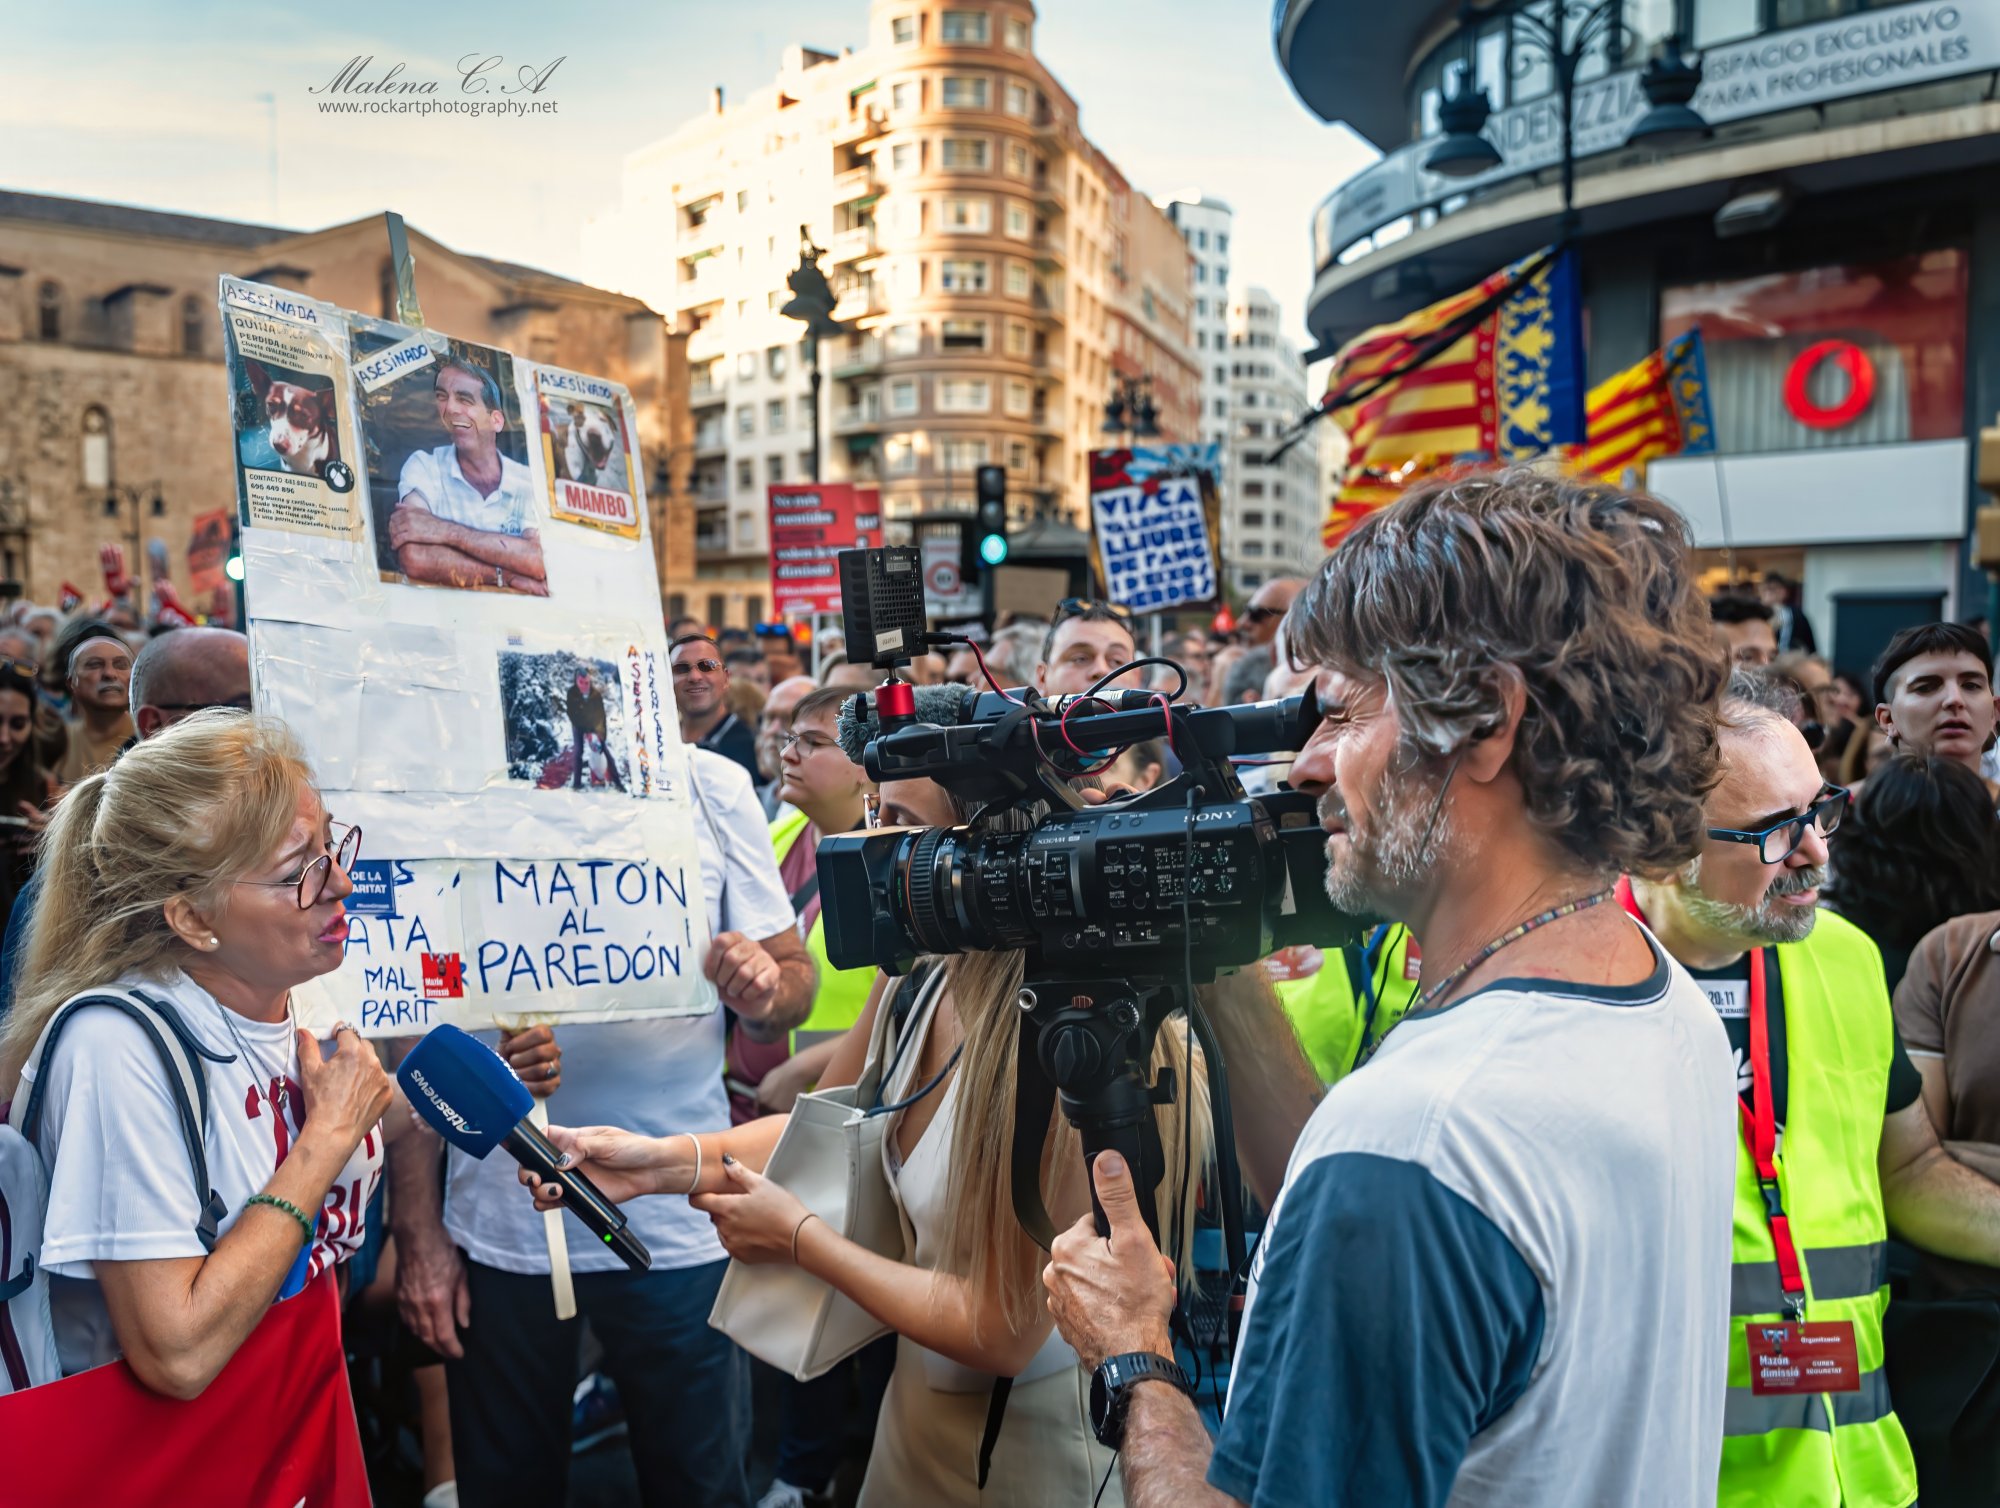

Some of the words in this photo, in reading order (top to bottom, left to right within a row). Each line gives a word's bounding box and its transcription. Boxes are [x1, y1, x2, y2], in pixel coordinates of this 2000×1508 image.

[1815, 6, 1961, 58] EXCLUSIVO
[1765, 35, 1971, 94] PROFESIONALES
[227, 284, 317, 323] ASESINADA
[239, 332, 280, 348] PERDIDA
[358, 344, 428, 384] ASESINADO
[249, 473, 283, 483] CONTACTO
[565, 484, 627, 518] MAMBO
[1041, 823, 1066, 832] 4K
[351, 871, 366, 881] DE
[367, 871, 382, 882] LA
[352, 883, 387, 894] ARITAT
[496, 858, 687, 908] MATÓN
[344, 915, 433, 958] ATA
[559, 908, 605, 937] AL
[478, 930, 681, 993] PAREDÓN
[411, 1069, 483, 1134] Atlasnews
[1759, 1354, 1790, 1367] Mazón
[1760, 1366, 1800, 1379] dimissió
